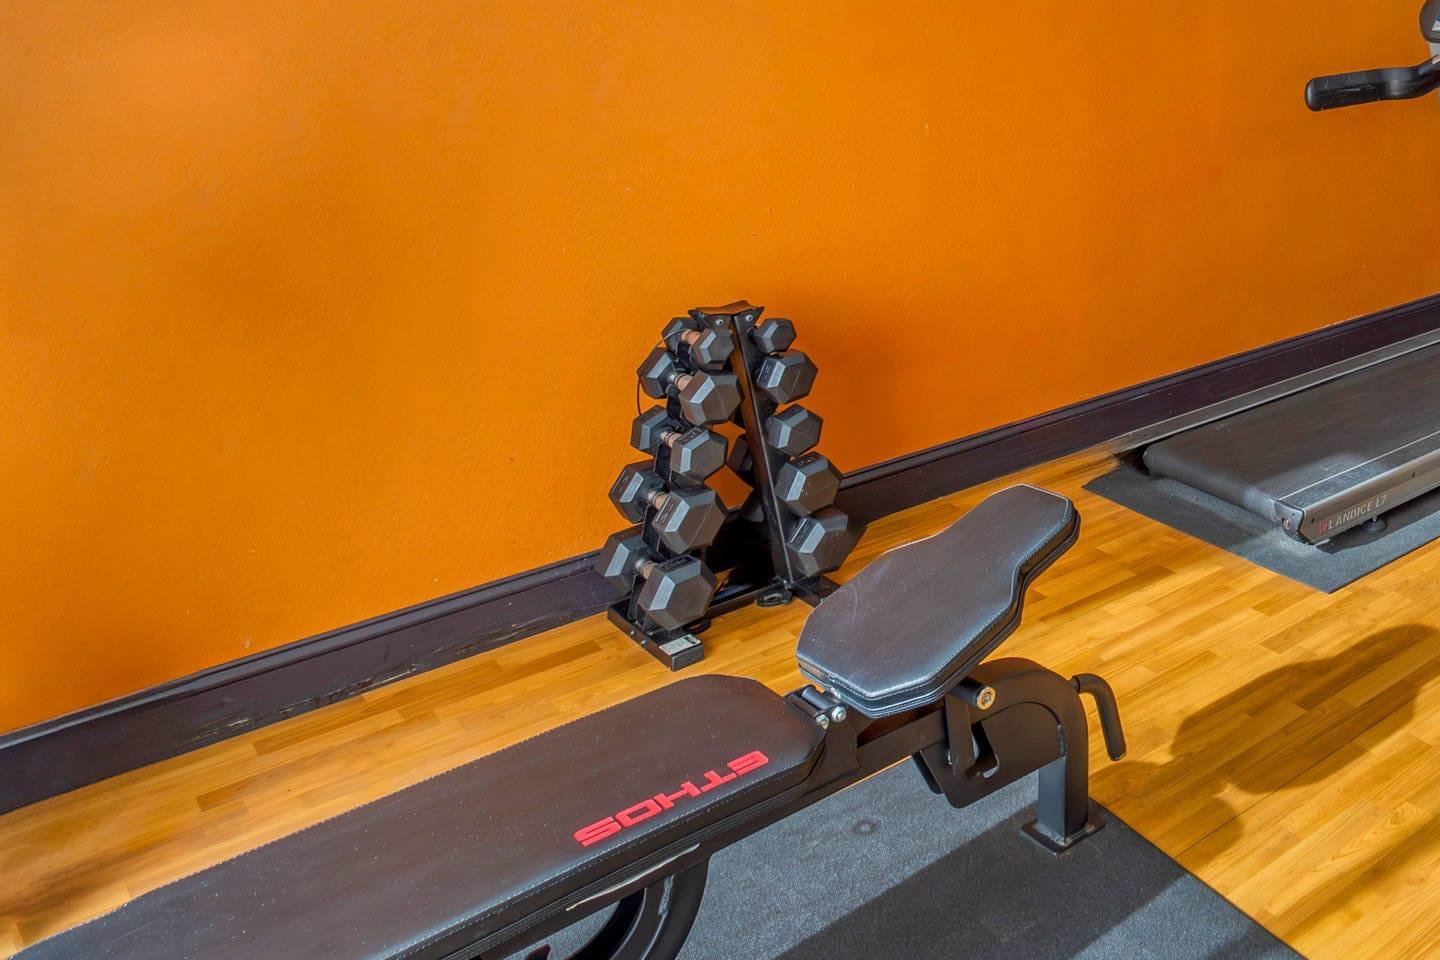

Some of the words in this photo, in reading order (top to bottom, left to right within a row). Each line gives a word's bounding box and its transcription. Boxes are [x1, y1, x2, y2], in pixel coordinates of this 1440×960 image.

[1328, 500, 1373, 529] LANDICE
[1375, 494, 1388, 507] L7
[573, 750, 769, 848] ETHOS
